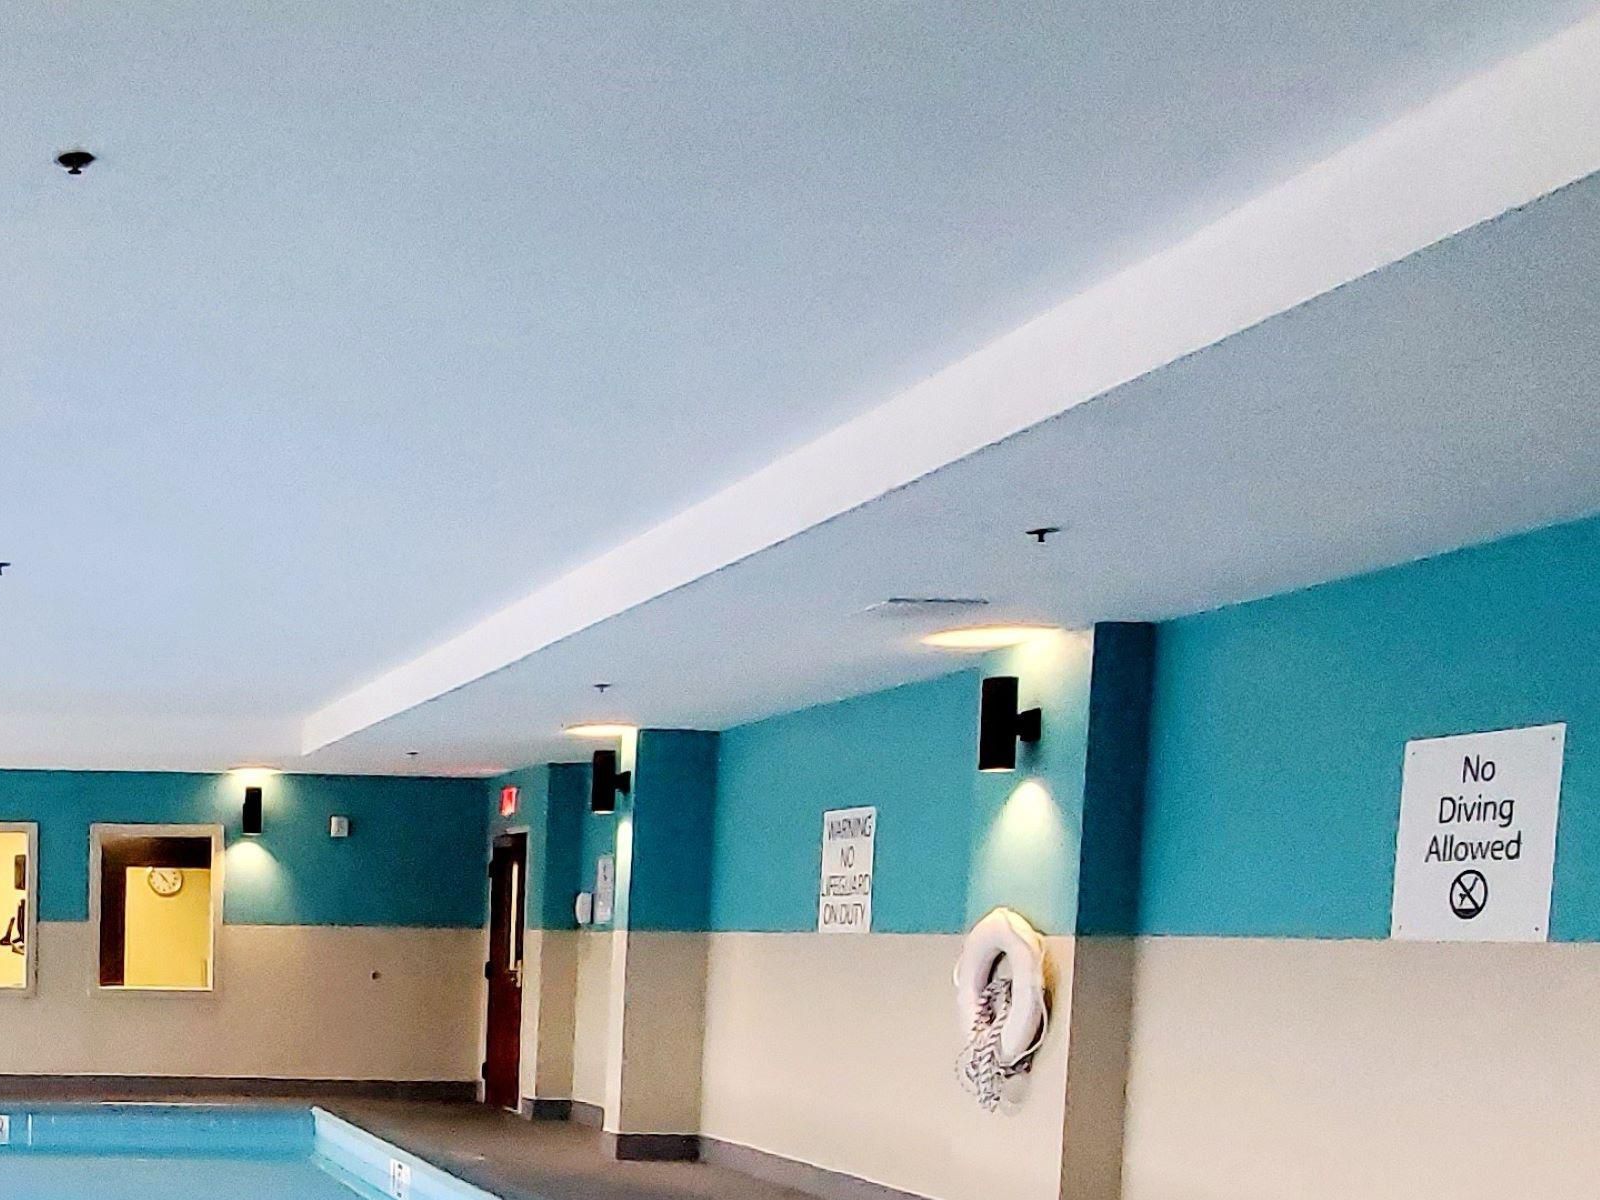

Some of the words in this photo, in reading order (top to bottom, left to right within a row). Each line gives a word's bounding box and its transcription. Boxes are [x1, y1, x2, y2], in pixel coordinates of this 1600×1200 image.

[1462, 754, 1496, 783] No
[1438, 793, 1515, 828] Diving
[828, 813, 873, 840] WARNING
[840, 845, 855, 868] NO
[1424, 830, 1522, 863] Allowed
[823, 903, 838, 925] ON
[839, 902, 866, 925] DUTY
